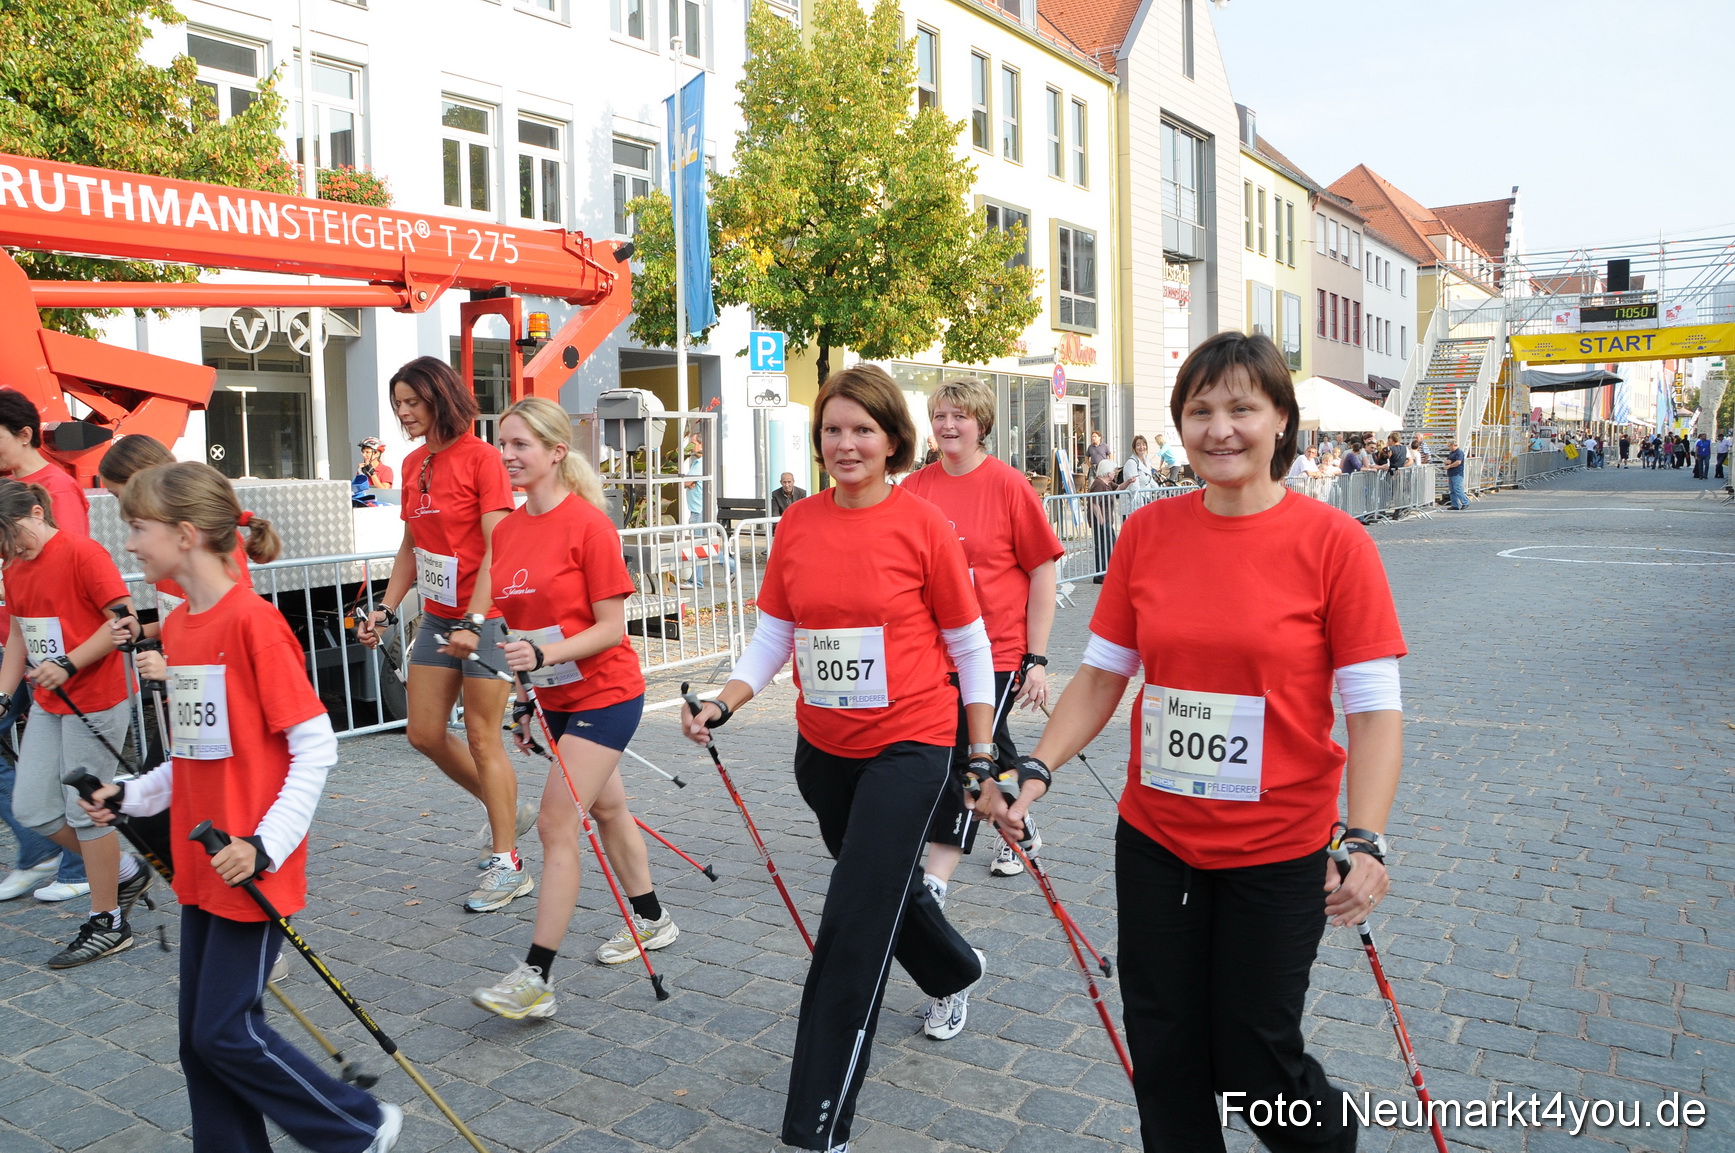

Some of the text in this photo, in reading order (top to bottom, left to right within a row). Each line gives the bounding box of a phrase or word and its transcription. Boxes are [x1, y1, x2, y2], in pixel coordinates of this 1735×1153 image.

[439, 224, 457, 257] T
[467, 228, 519, 264] 275
[757, 335, 777, 367] P
[1579, 334, 1657, 354] START
[1675, 373, 1683, 409] HOTEL
[425, 569, 451, 589] 8061
[813, 635, 840, 650] Anke
[817, 659, 875, 681] 8057
[849, 694, 886, 704] PFLEIDERER
[1168, 695, 1211, 720] Maria
[1145, 722, 1152, 737] N
[1168, 729, 1249, 765] 8062
[1207, 782, 1258, 794] PFLEIDERER
